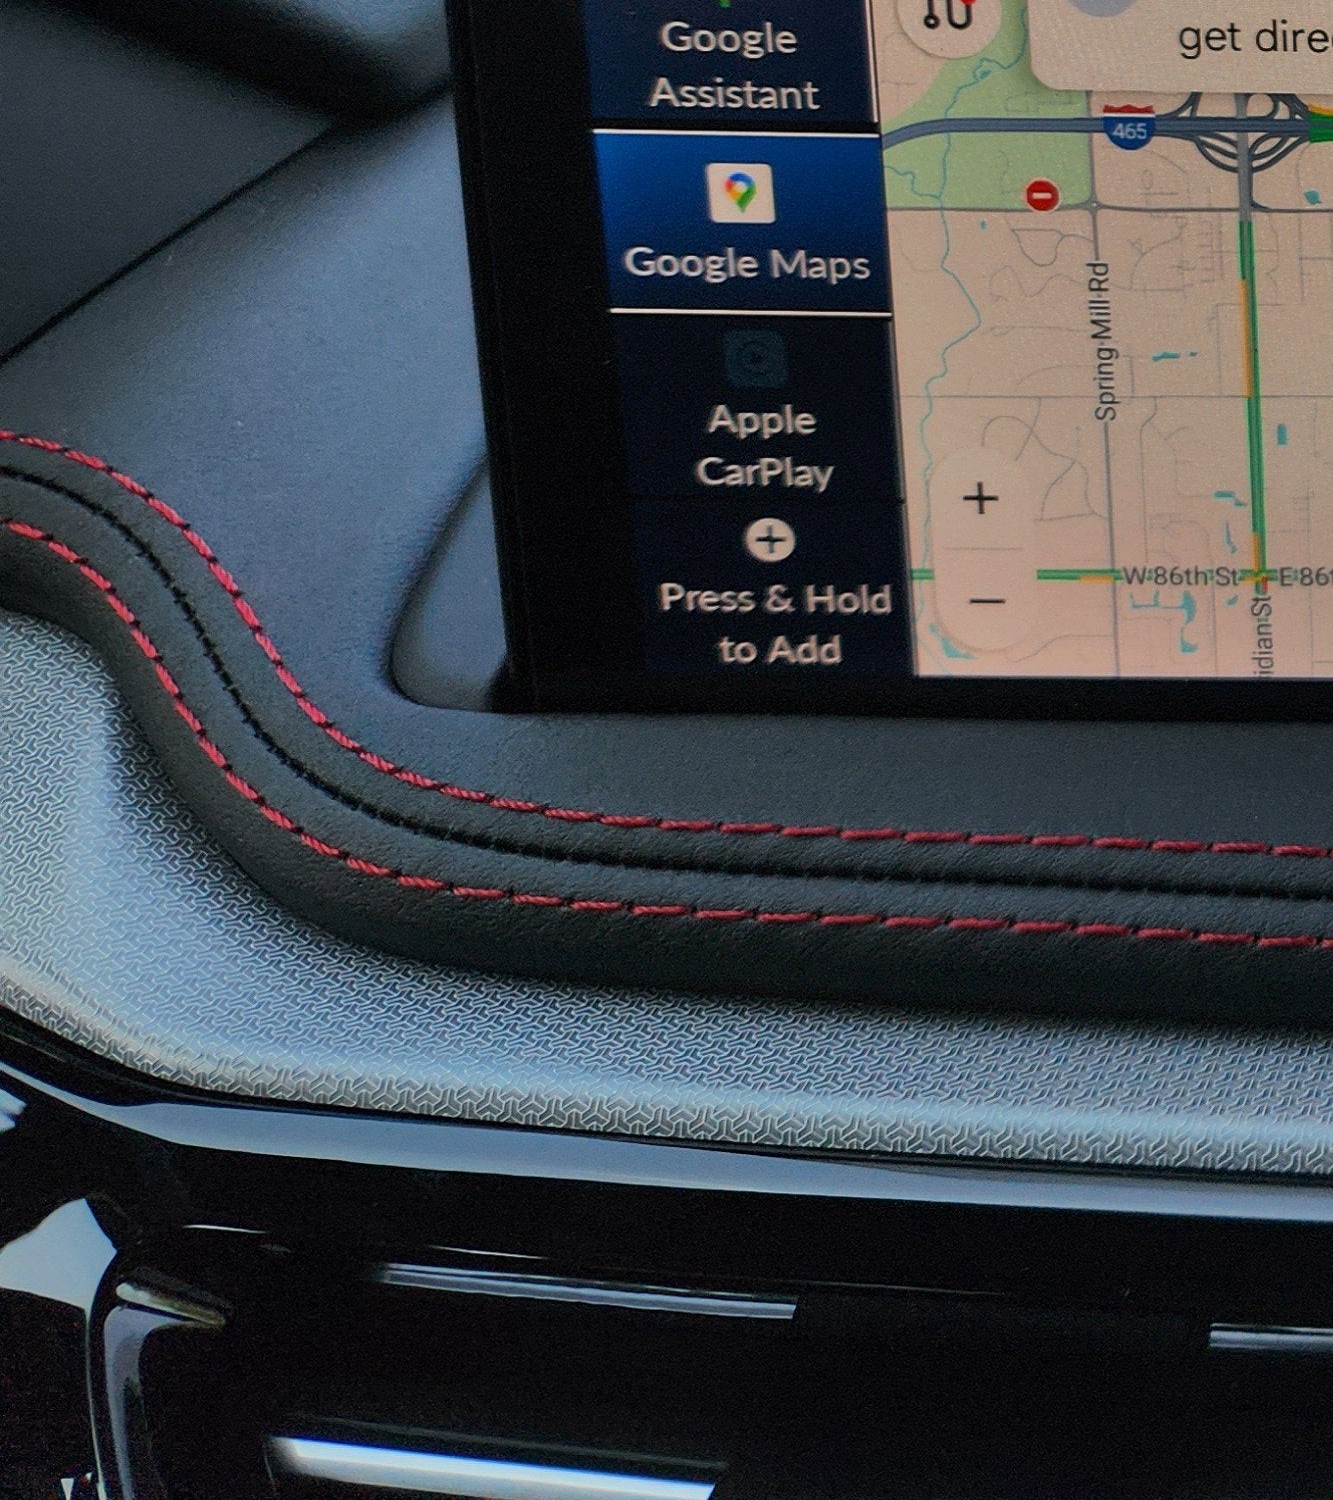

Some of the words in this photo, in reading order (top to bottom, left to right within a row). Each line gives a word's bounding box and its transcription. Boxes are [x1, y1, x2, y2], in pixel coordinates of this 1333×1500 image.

[661, 20, 799, 60] Google
[1178, 22, 1243, 61] get
[650, 76, 820, 111] Assistant
[1112, 122, 1147, 139] 465
[623, 245, 759, 284] Google
[771, 248, 872, 286] Maps
[1086, 262, 1109, 292] Rd
[1088, 300, 1112, 339] Mill
[1094, 347, 1122, 421] Spring
[707, 404, 818, 441] Apple
[696, 457, 835, 493] CarPlay
[1123, 566, 1147, 585] W
[1153, 566, 1209, 586] 86th
[1215, 566, 1240, 586] St
[1280, 567, 1294, 587] E
[658, 582, 757, 616] Press
[763, 583, 797, 615] &
[806, 583, 893, 616] Hold
[1251, 596, 1272, 618] St
[718, 638, 758, 666] to
[764, 633, 843, 666] Add
[1252, 622, 1275, 677] idian
